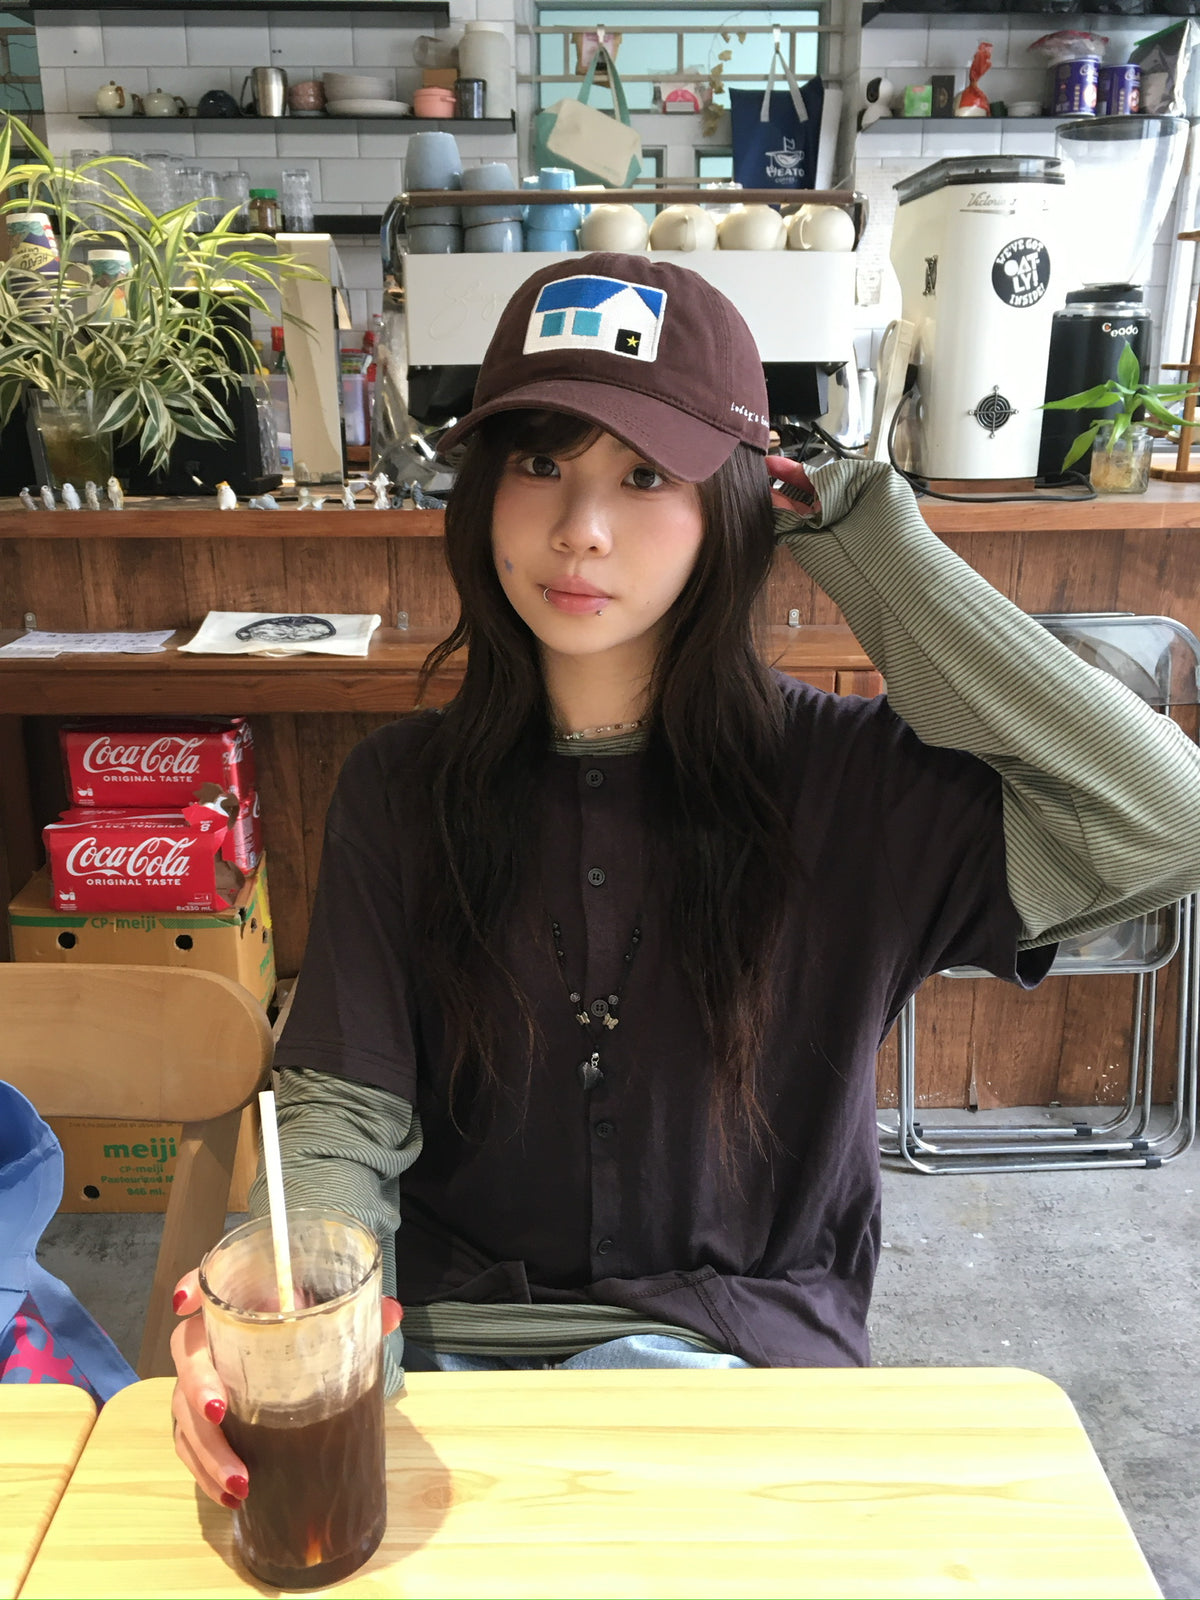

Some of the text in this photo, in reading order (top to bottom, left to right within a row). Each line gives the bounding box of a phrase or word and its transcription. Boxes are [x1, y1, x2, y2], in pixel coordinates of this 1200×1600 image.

[765, 165, 805, 177] HEATO
[996, 238, 1045, 265] WE'VE GOT
[1012, 270, 1039, 294] LY!
[1009, 283, 1046, 306] INSIDE!
[1102, 322, 1138, 338] Ceado
[83, 736, 206, 774] Coca-Cola
[103, 775, 193, 783] ORIGINAL TASTE
[200, 823, 211, 832] 8
[66, 836, 198, 877] Coca-Cola
[86, 878, 182, 886] ORIGINAL TASTE
[90, 915, 157, 933] CP-meiji
[103, 1137, 177, 1163] meiji
[119, 1164, 164, 1175] CP-meiji
